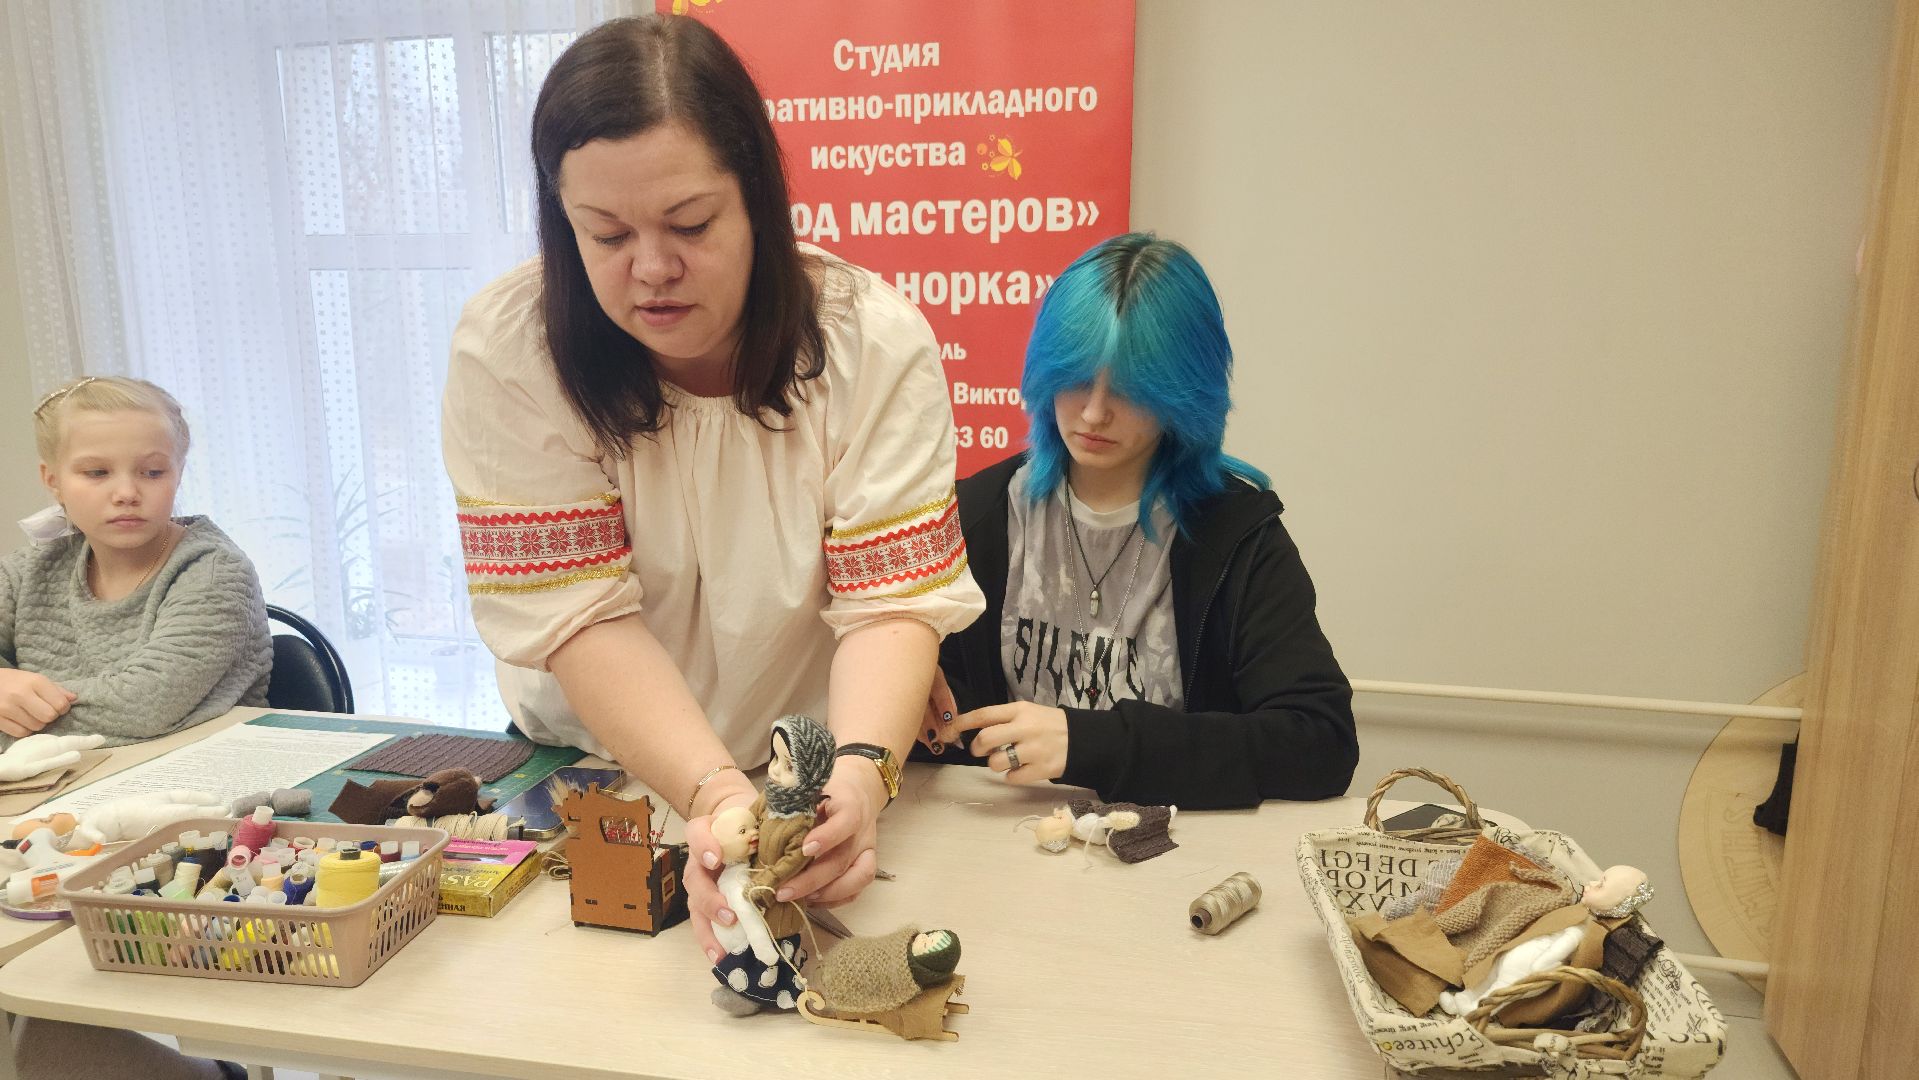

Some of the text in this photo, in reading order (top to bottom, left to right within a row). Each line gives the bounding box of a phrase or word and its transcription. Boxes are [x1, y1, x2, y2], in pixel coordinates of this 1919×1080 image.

[833, 39, 940, 77] Студия
[811, 141, 966, 176] искусства
[790, 197, 1100, 244] од мастеров»
[939, 342, 967, 360] ль
[953, 382, 1027, 411] Викто
[979, 425, 1009, 449] 60
[1013, 616, 1146, 710] SILENE
